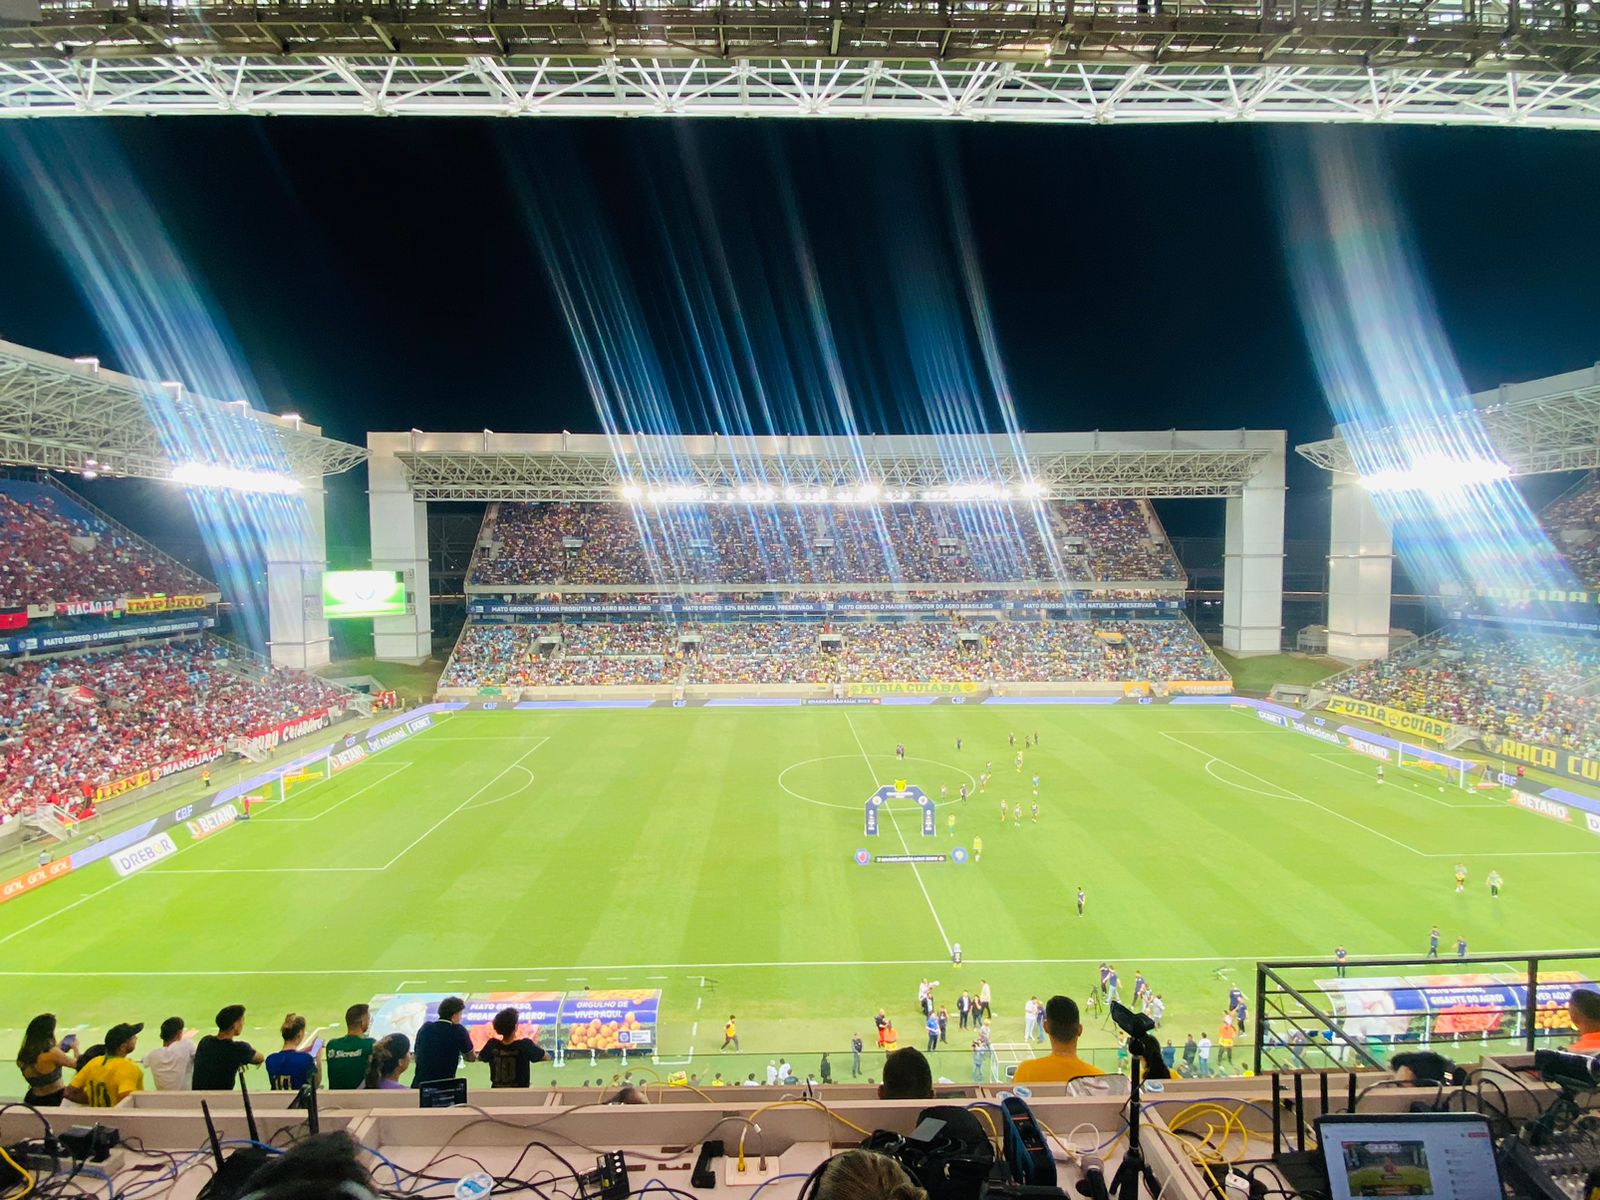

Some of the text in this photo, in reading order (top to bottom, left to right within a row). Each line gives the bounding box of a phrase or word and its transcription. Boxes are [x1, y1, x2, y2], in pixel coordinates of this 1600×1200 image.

[43, 637, 63, 646] MATO
[1502, 738, 1557, 769] RAÇA
[1497, 772, 1517, 786] CBF
[176, 804, 193, 821] CBF
[4, 860, 69, 895] GOL GOL GOL
[470, 1002, 495, 1010] MATO
[574, 1010, 598, 1019] VIVER
[335, 1048, 362, 1059] Sicredi
